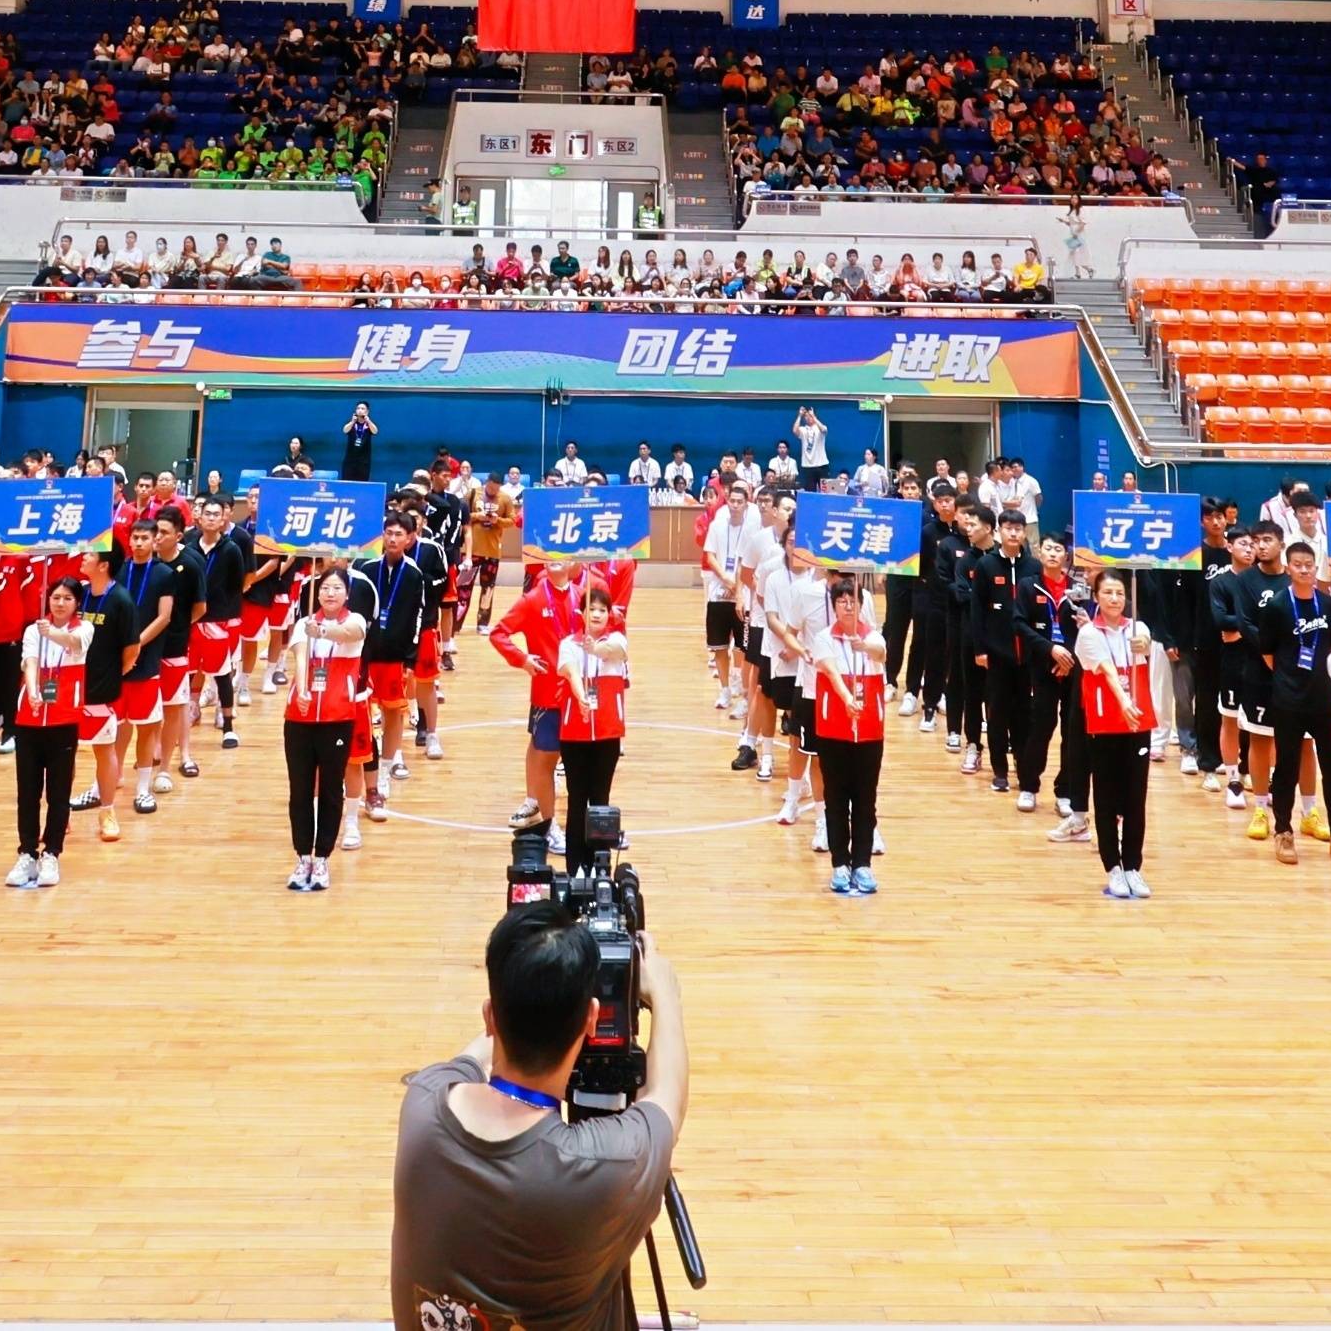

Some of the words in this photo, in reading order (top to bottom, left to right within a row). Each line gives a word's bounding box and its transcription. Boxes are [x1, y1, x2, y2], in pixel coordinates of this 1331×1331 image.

[485, 138, 517, 151] 东区1
[529, 132, 589, 155] 东门
[603, 140, 635, 153] 东区2
[76, 319, 202, 369] 参与
[348, 323, 471, 372] 健身
[615, 328, 737, 376] 团结
[883, 332, 1002, 383] 进取
[7, 503, 85, 536] 上海
[280, 505, 357, 538] 河北
[548, 511, 624, 545] 北京
[1099, 518, 1174, 550] 辽宁
[819, 520, 895, 556] 天津
[1228, 690, 1236, 705] 1
[1255, 706, 1266, 723] 7
